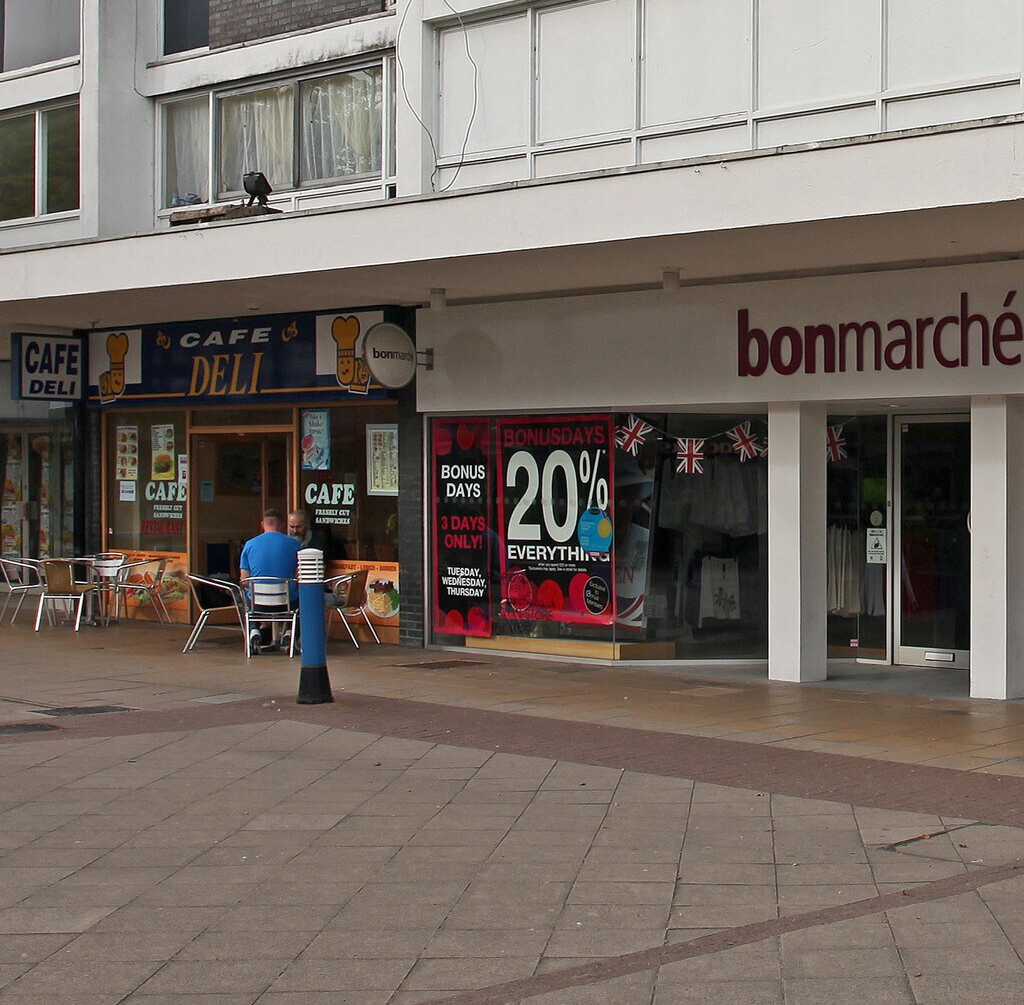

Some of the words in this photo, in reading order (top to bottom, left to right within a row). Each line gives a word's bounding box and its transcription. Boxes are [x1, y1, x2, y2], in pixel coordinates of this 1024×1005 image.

[179, 327, 272, 348] CAFE
[737, 290, 1024, 377] bonmarché
[25, 341, 79, 375] CAFE
[186, 352, 265, 396] DELI
[29, 380, 76, 395] DELI
[441, 464, 486, 480] BONUS
[145, 481, 187, 502] CAFE
[304, 482, 356, 506] CAFE
[446, 483, 481, 498] DAYS
[441, 515, 449, 530] 3
[451, 516, 486, 532] DAYS
[444, 534, 483, 549] ONLY!
[447, 566, 482, 579] TUESDAY,
[441, 576, 487, 589] WEDNESDAY,
[446, 586, 484, 597] THURSDAY
